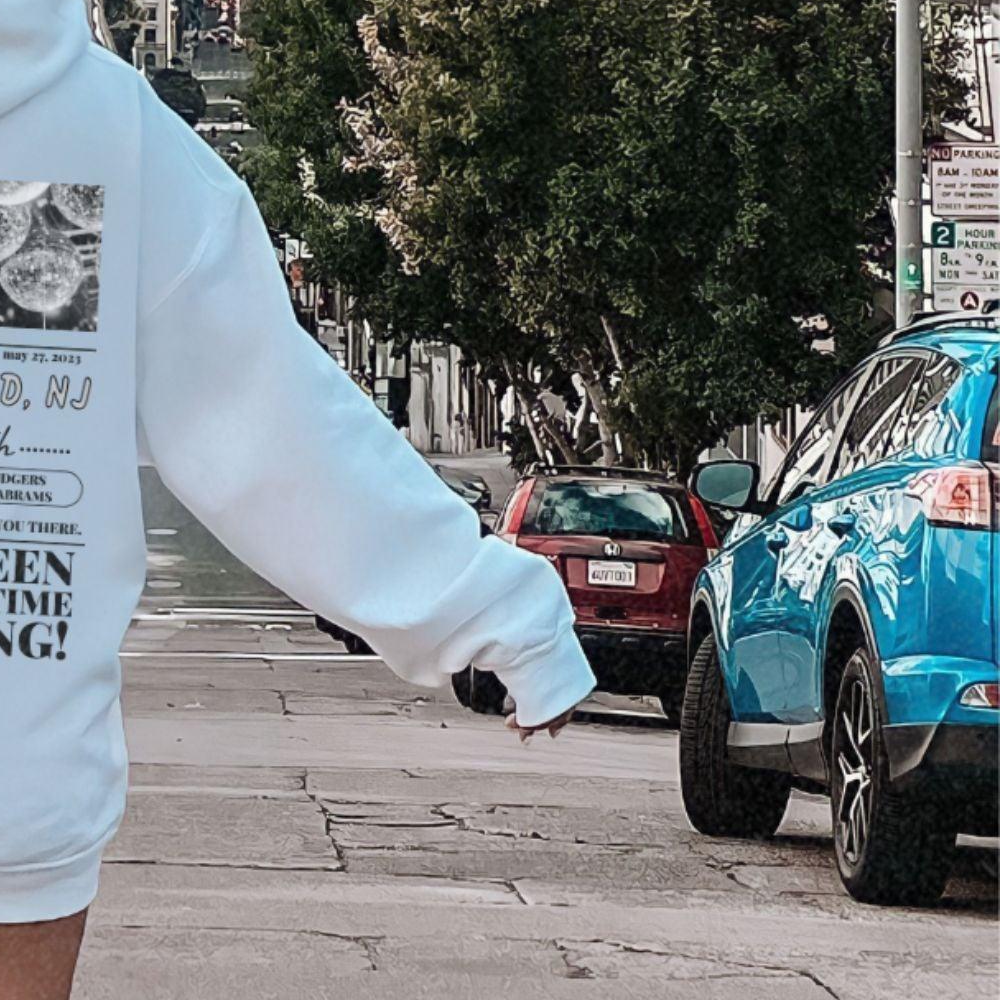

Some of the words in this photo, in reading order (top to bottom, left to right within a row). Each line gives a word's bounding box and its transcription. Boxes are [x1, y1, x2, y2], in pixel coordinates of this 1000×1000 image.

[931, 148, 950, 160] NO
[936, 225, 950, 246] 2
[965, 229, 995, 239] HOUR
[44, 374, 93, 411] NJ
